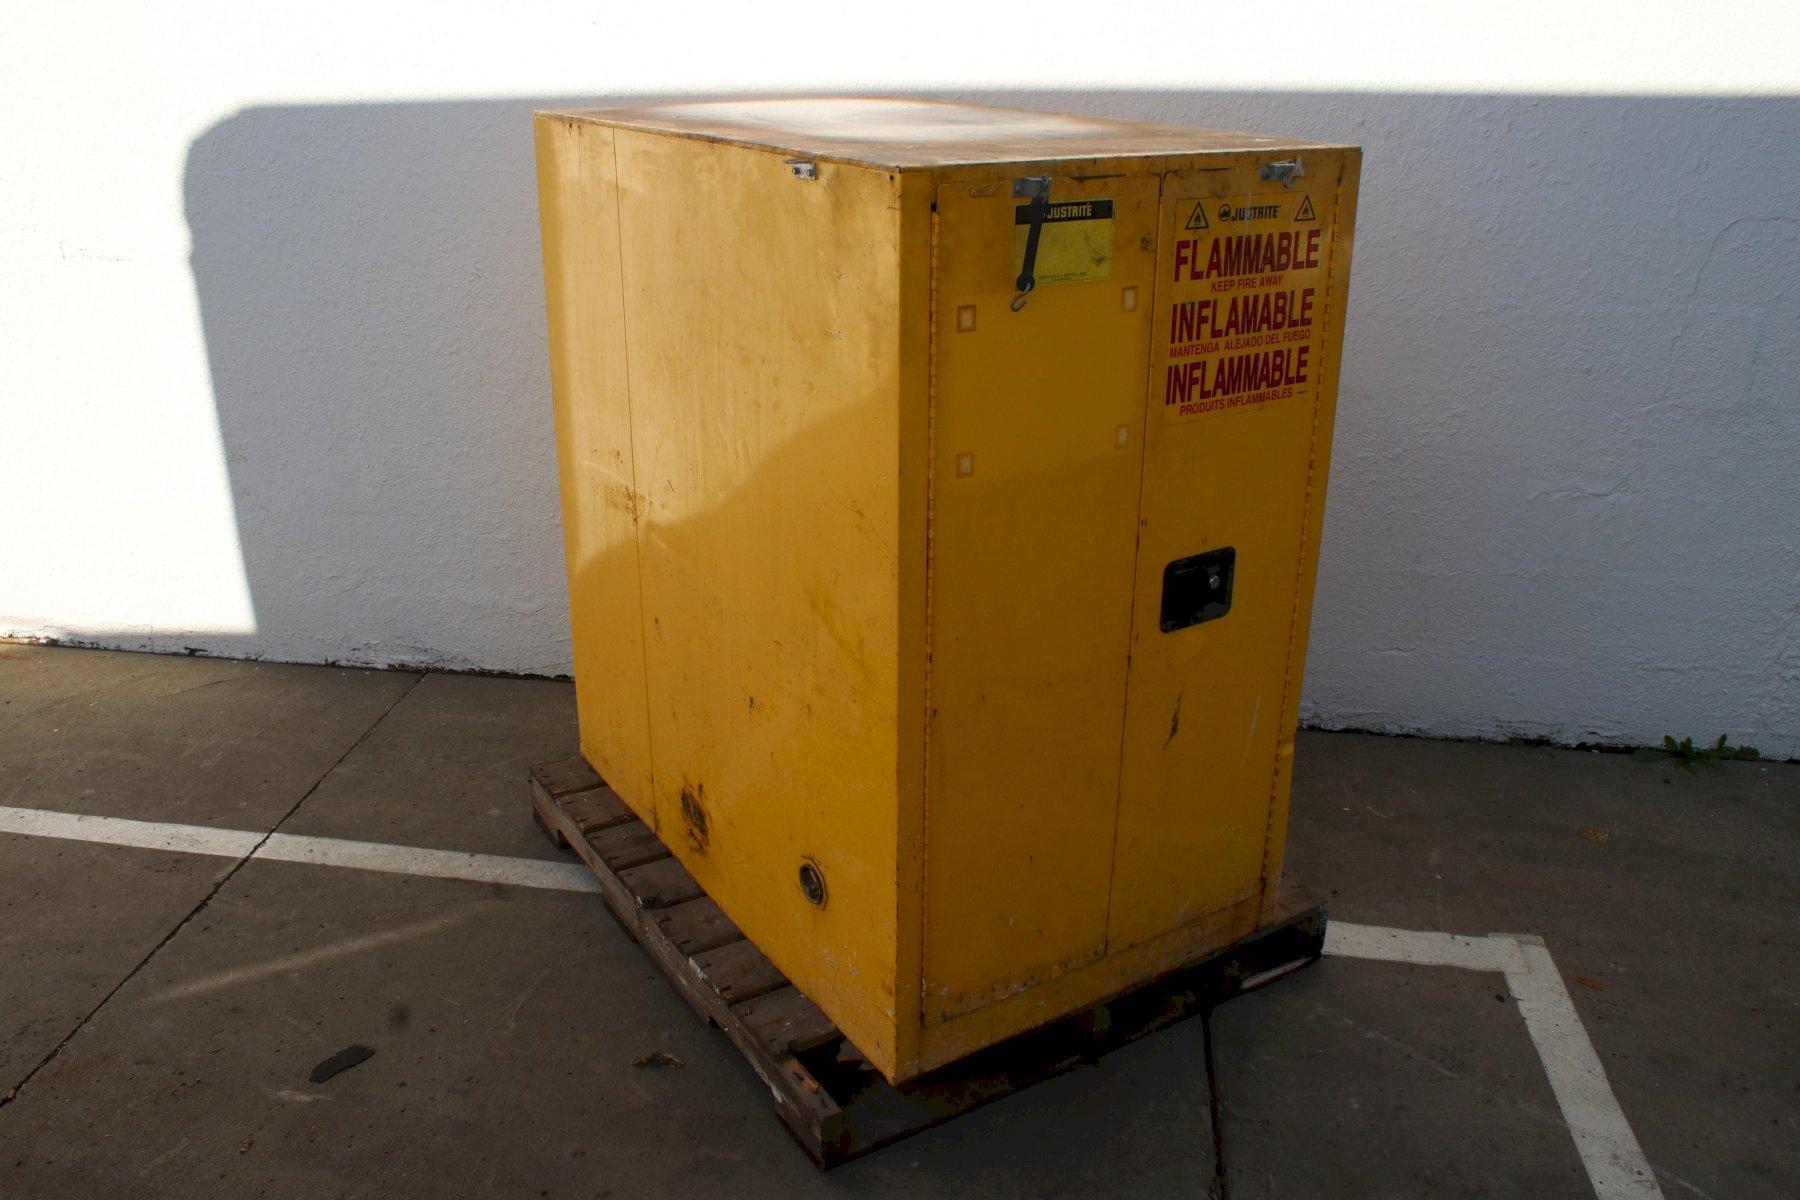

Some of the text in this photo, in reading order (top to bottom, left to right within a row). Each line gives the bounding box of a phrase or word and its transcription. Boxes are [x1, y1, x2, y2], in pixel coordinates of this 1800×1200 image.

[1046, 204, 1093, 220] JUSTRITE
[1174, 229, 1321, 282] FLAMMABLE
[1211, 275, 1284, 293] KEEP FIRE AWAY
[1170, 288, 1315, 344] INFLAMABLE
[1169, 329, 1311, 359] MANTENGA ALEJADO DEL FUEGO
[1165, 345, 1310, 405] INFLAMMABLE
[1179, 387, 1293, 416] PRODUITS INFLAMMABLES
